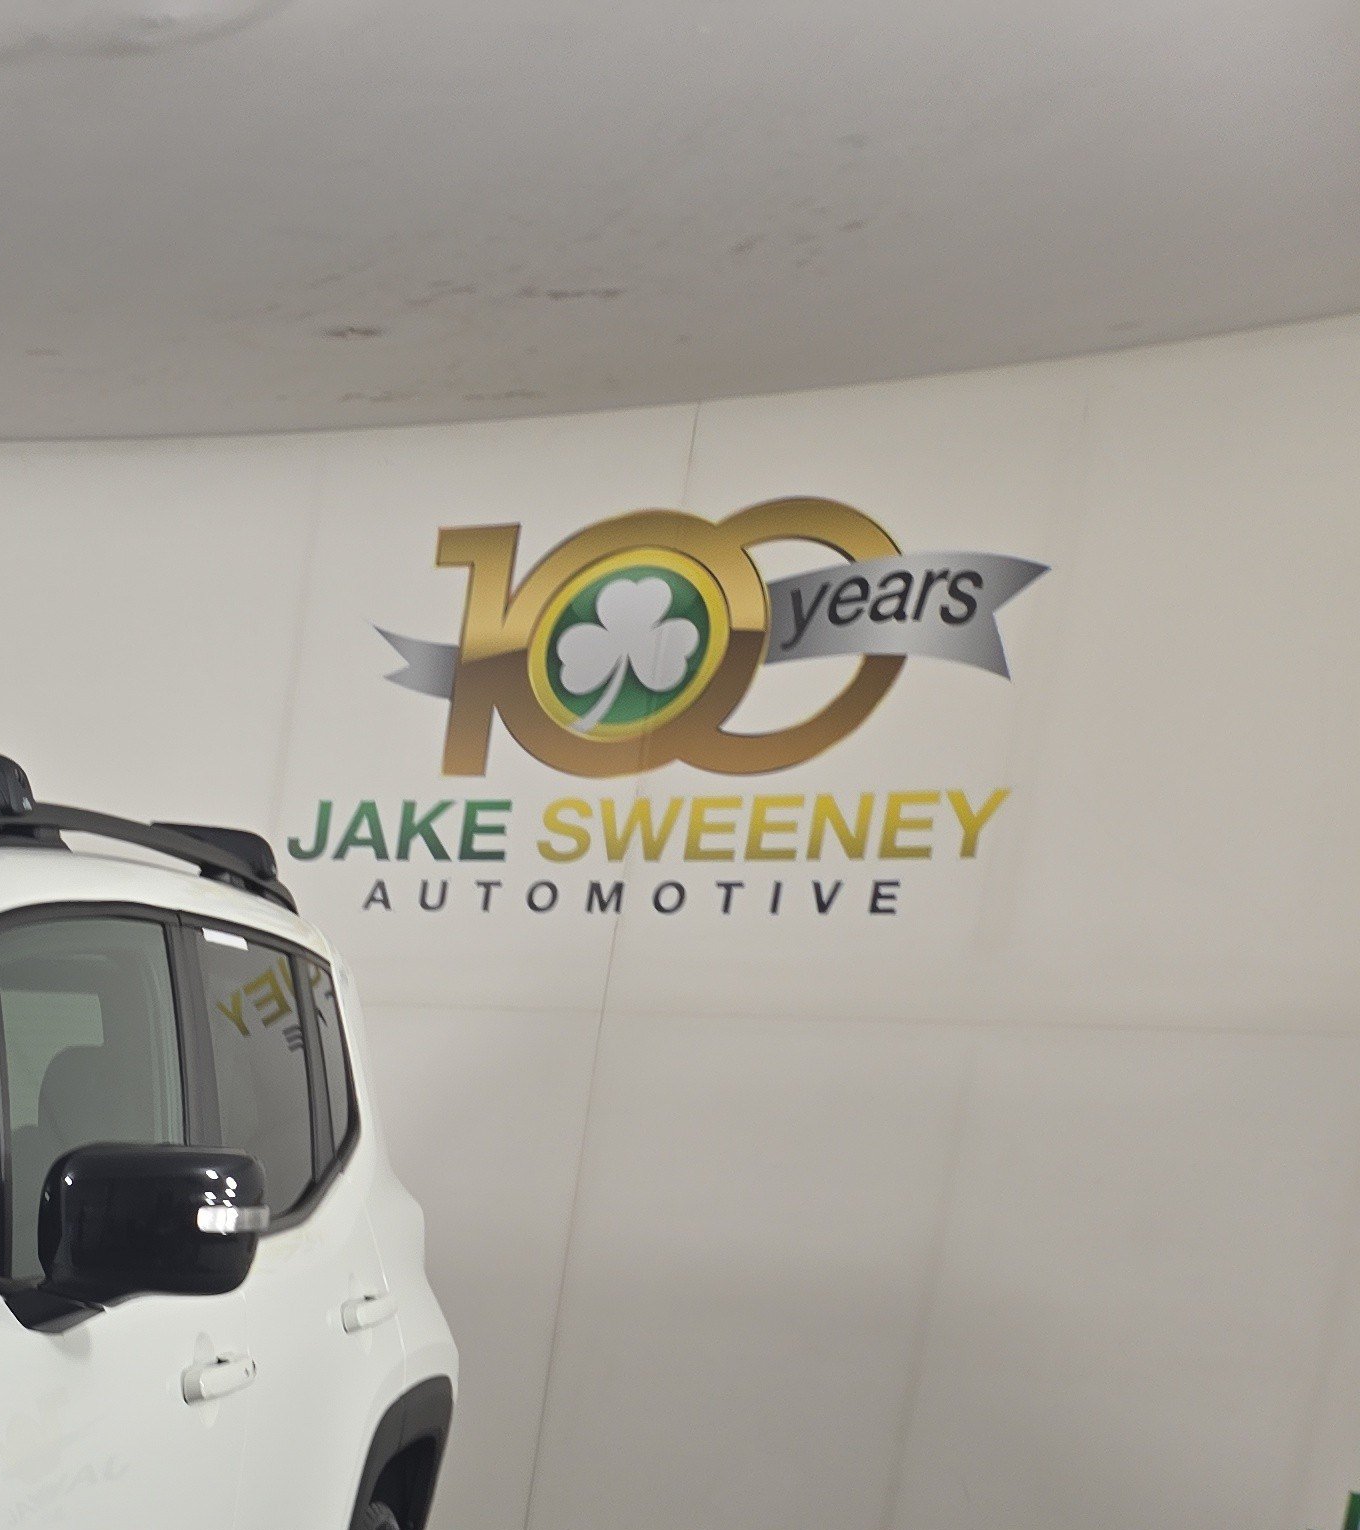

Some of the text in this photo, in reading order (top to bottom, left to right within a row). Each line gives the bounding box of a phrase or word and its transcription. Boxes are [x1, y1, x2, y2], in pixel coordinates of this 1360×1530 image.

[435, 496, 908, 779] 100
[780, 566, 984, 652] years
[287, 787, 1013, 864] JAKE SWEENEY
[363, 879, 901, 916] AUTOMOTIVE
